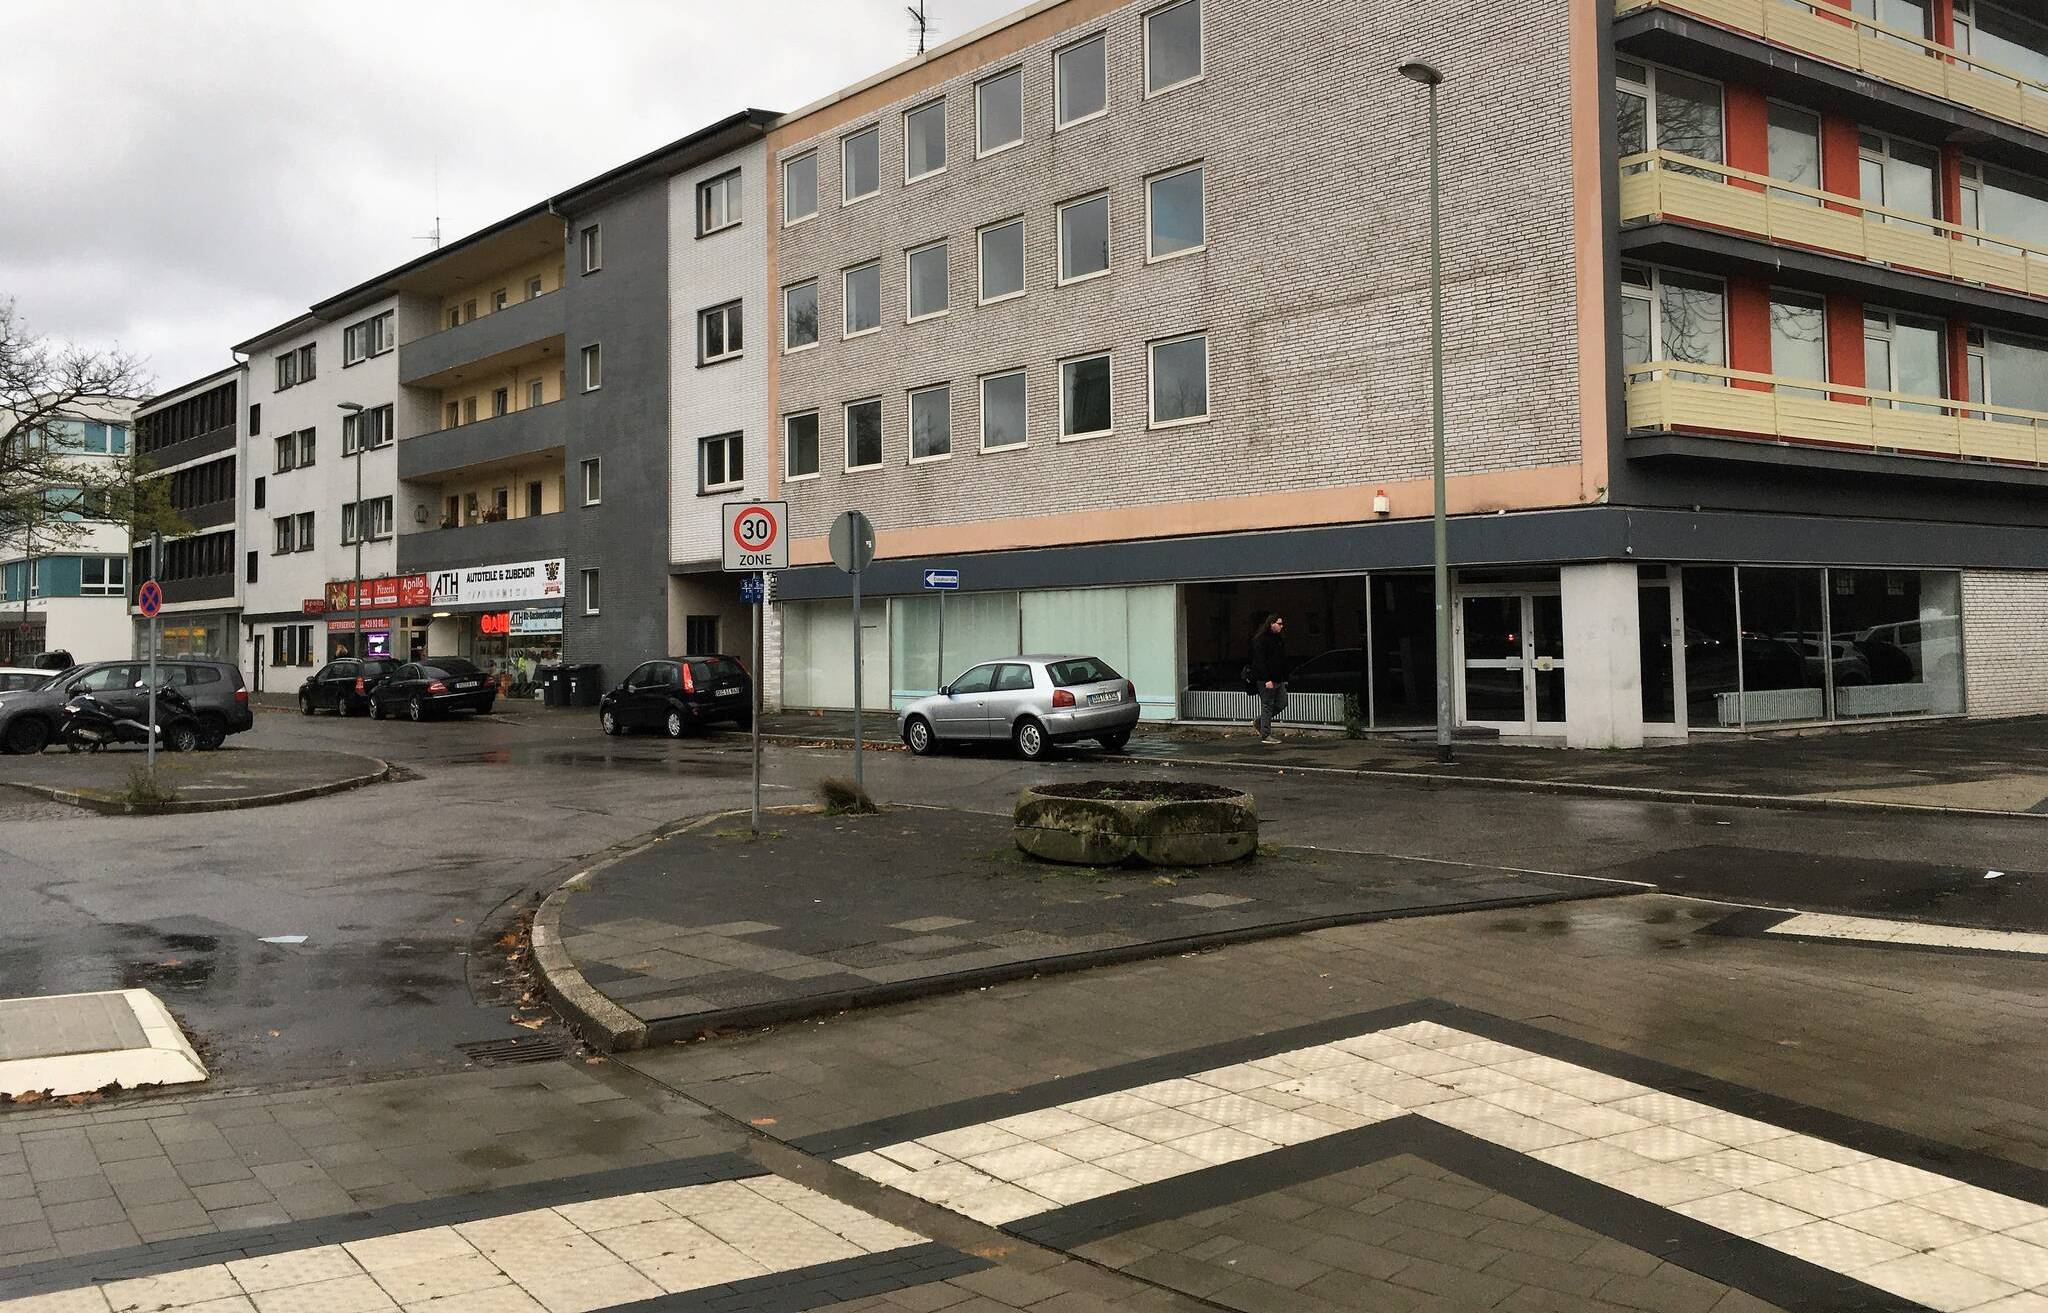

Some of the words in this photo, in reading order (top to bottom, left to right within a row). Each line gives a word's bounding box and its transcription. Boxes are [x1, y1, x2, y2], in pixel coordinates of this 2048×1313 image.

[742, 519, 768, 539] 30
[739, 554, 772, 566] ZONE
[466, 570, 498, 583] AUTOTEILE
[402, 577, 424, 592] Apollo
[432, 572, 459, 596] ATH
[510, 612, 523, 625] ATH
